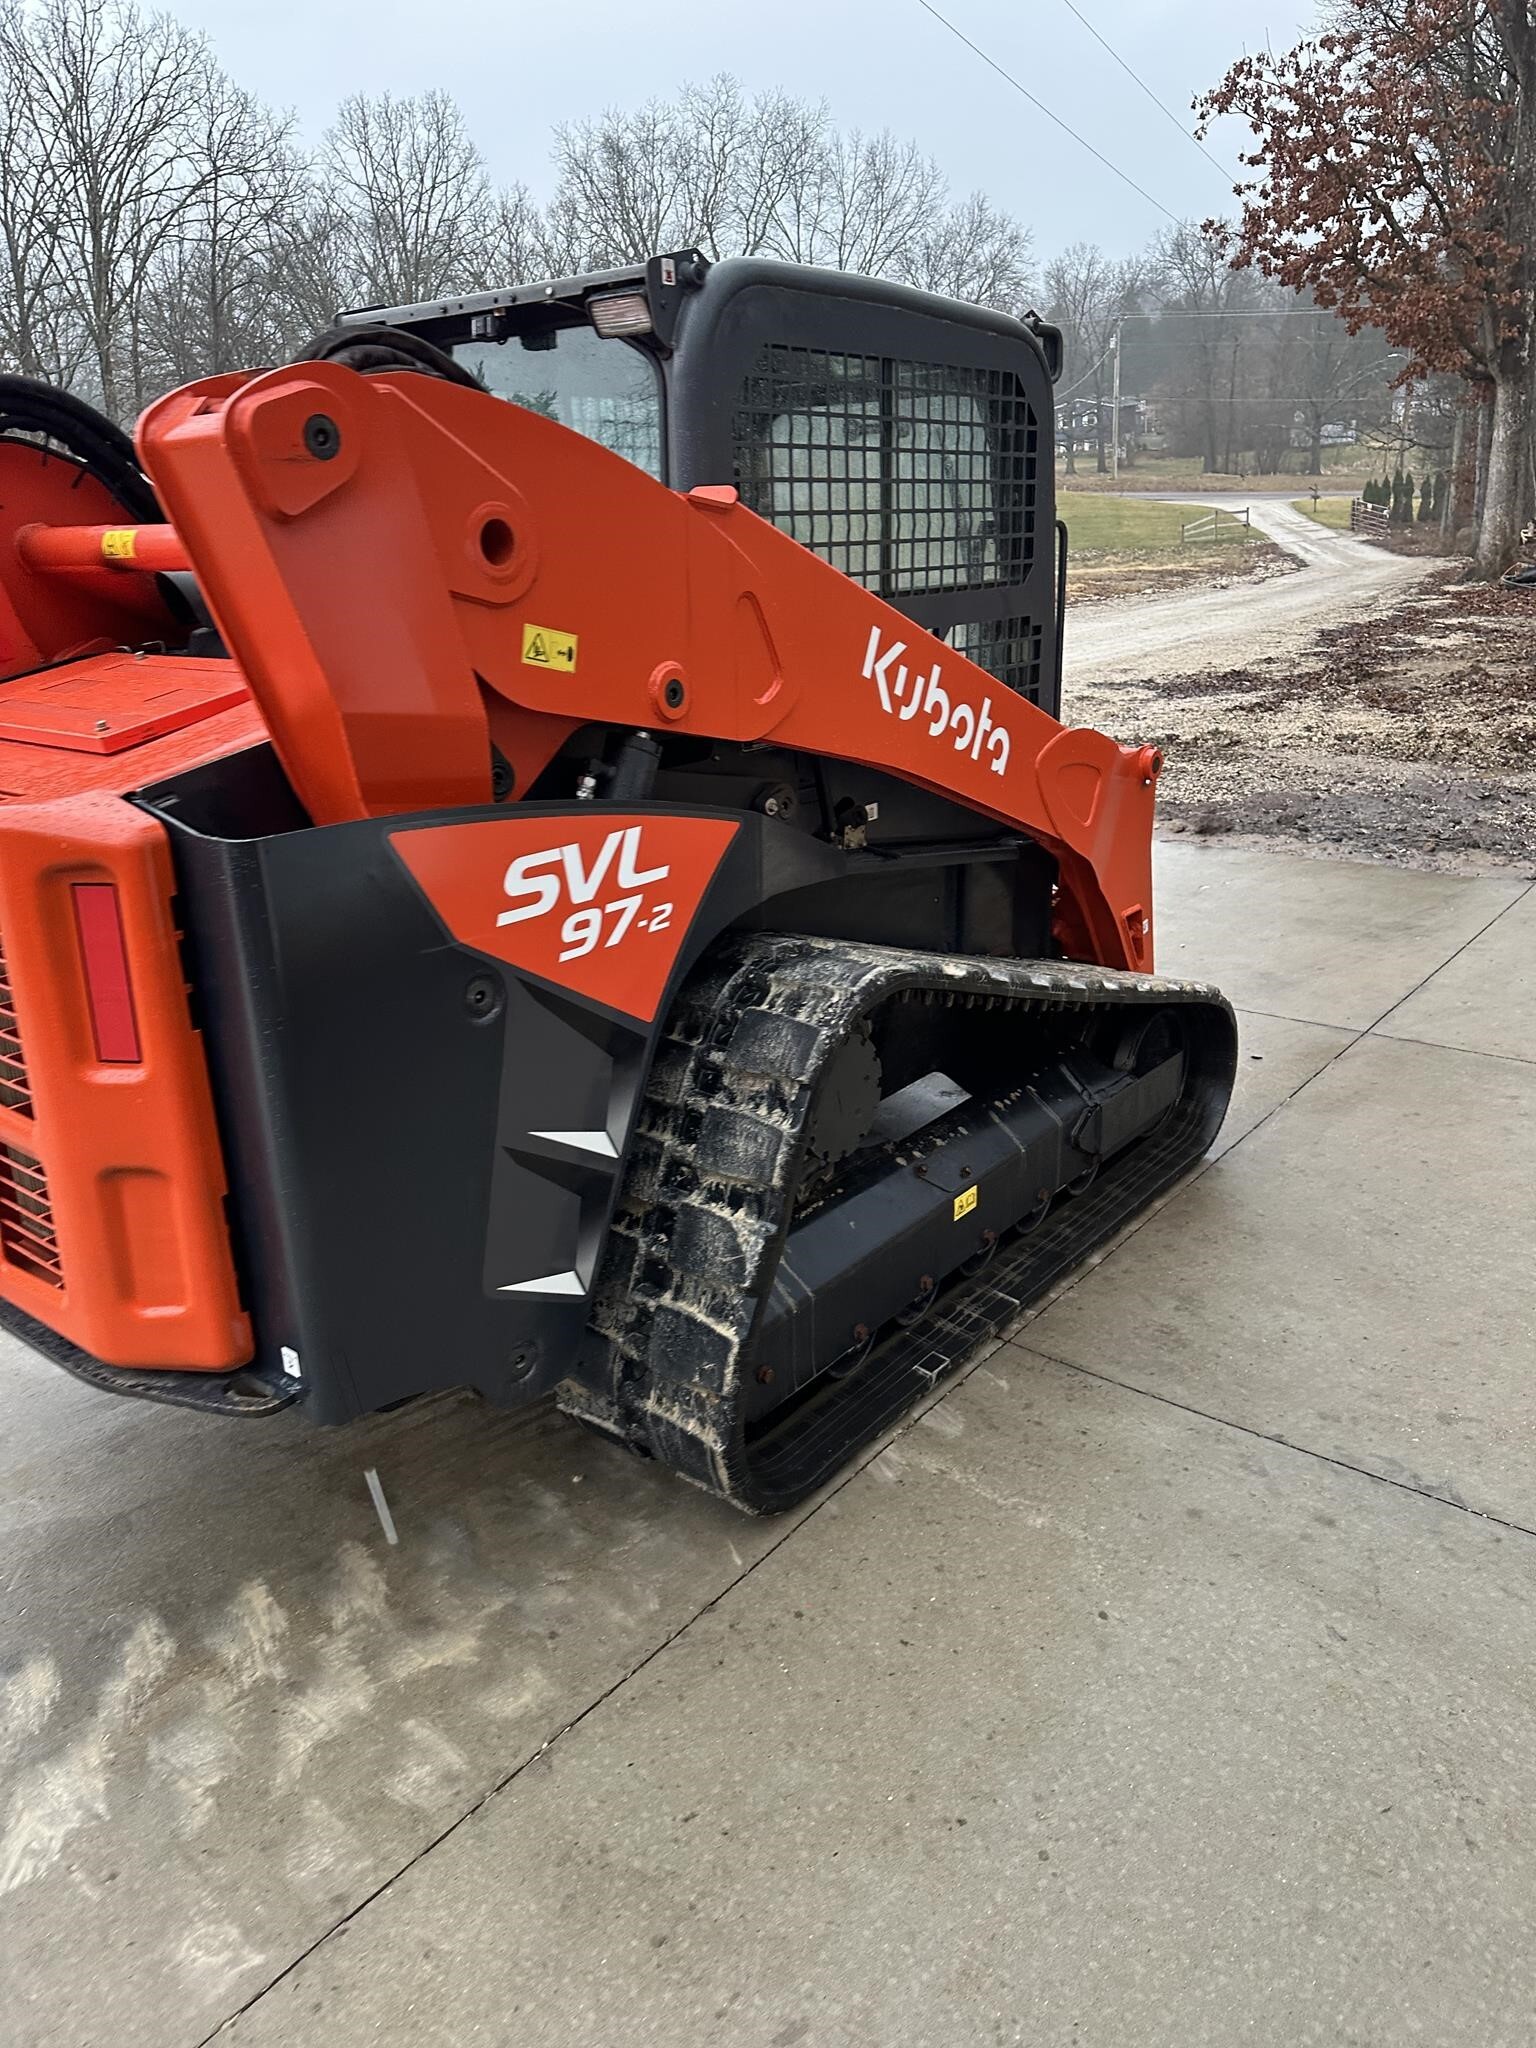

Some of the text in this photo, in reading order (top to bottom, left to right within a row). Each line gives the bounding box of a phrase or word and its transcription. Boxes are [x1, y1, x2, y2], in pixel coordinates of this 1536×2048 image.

[861, 625, 1011, 776] Kubota
[496, 825, 670, 928] SVL
[558, 894, 674, 963] 97-2
